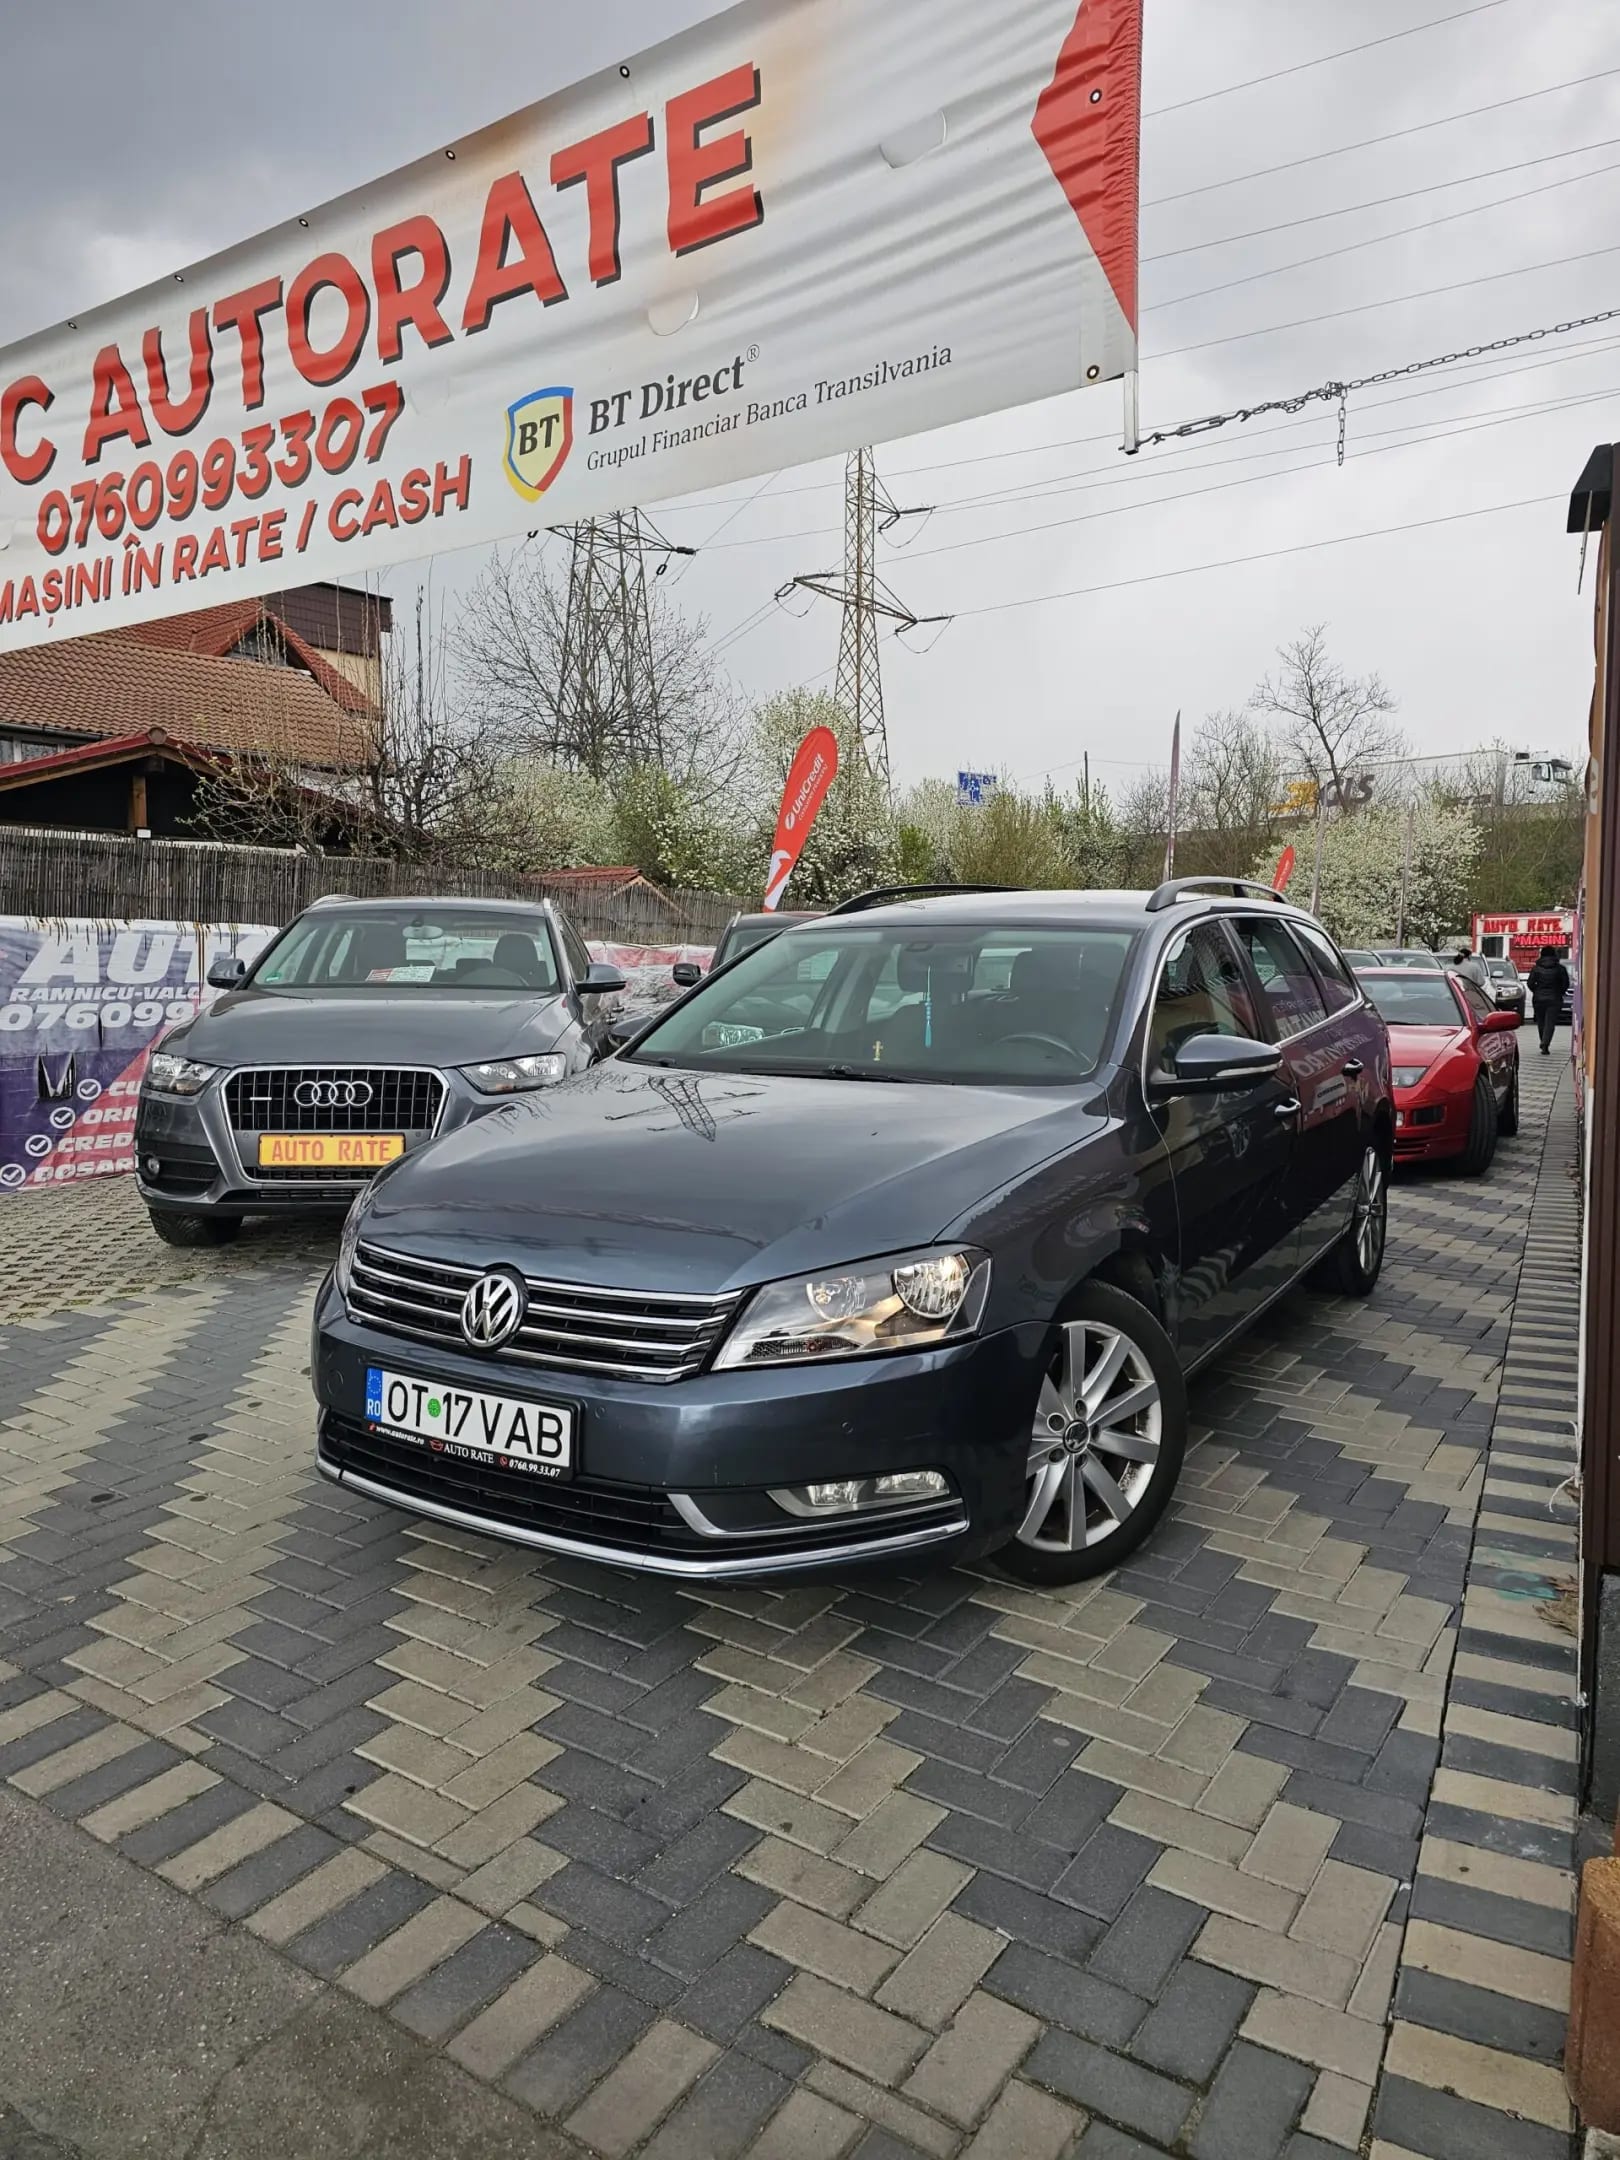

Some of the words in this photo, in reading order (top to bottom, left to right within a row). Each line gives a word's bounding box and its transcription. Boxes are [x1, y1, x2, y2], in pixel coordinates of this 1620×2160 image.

[0, 376, 55, 486] C
[82, 61, 763, 463] AUTORATE
[587, 436, 647, 471] Grupul
[652, 410, 741, 454] Financiar
[745, 391, 807, 426] Banca
[815, 344, 953, 404] Transilvania
[588, 390, 631, 435] BT
[518, 413, 560, 456] BT
[37, 380, 406, 555] 0760993307
[122, 533, 164, 597] ÎN
[172, 506, 287, 584] RATE
[296, 499, 316, 553] /
[328, 454, 472, 544] CASH
[1483, 918, 1518, 933] AUTO
[1528, 918, 1562, 932] RATE
[272, 1140, 324, 1161] AUTO
[338, 1140, 391, 1162] RATE
[367, 1398, 381, 1417] RO
[388, 1381, 428, 1427] OT
[443, 1392, 472, 1437] 17
[480, 1400, 563, 1459] VAB
[443, 1443, 469, 1458] AUTO
[470, 1450, 495, 1464] RATE
